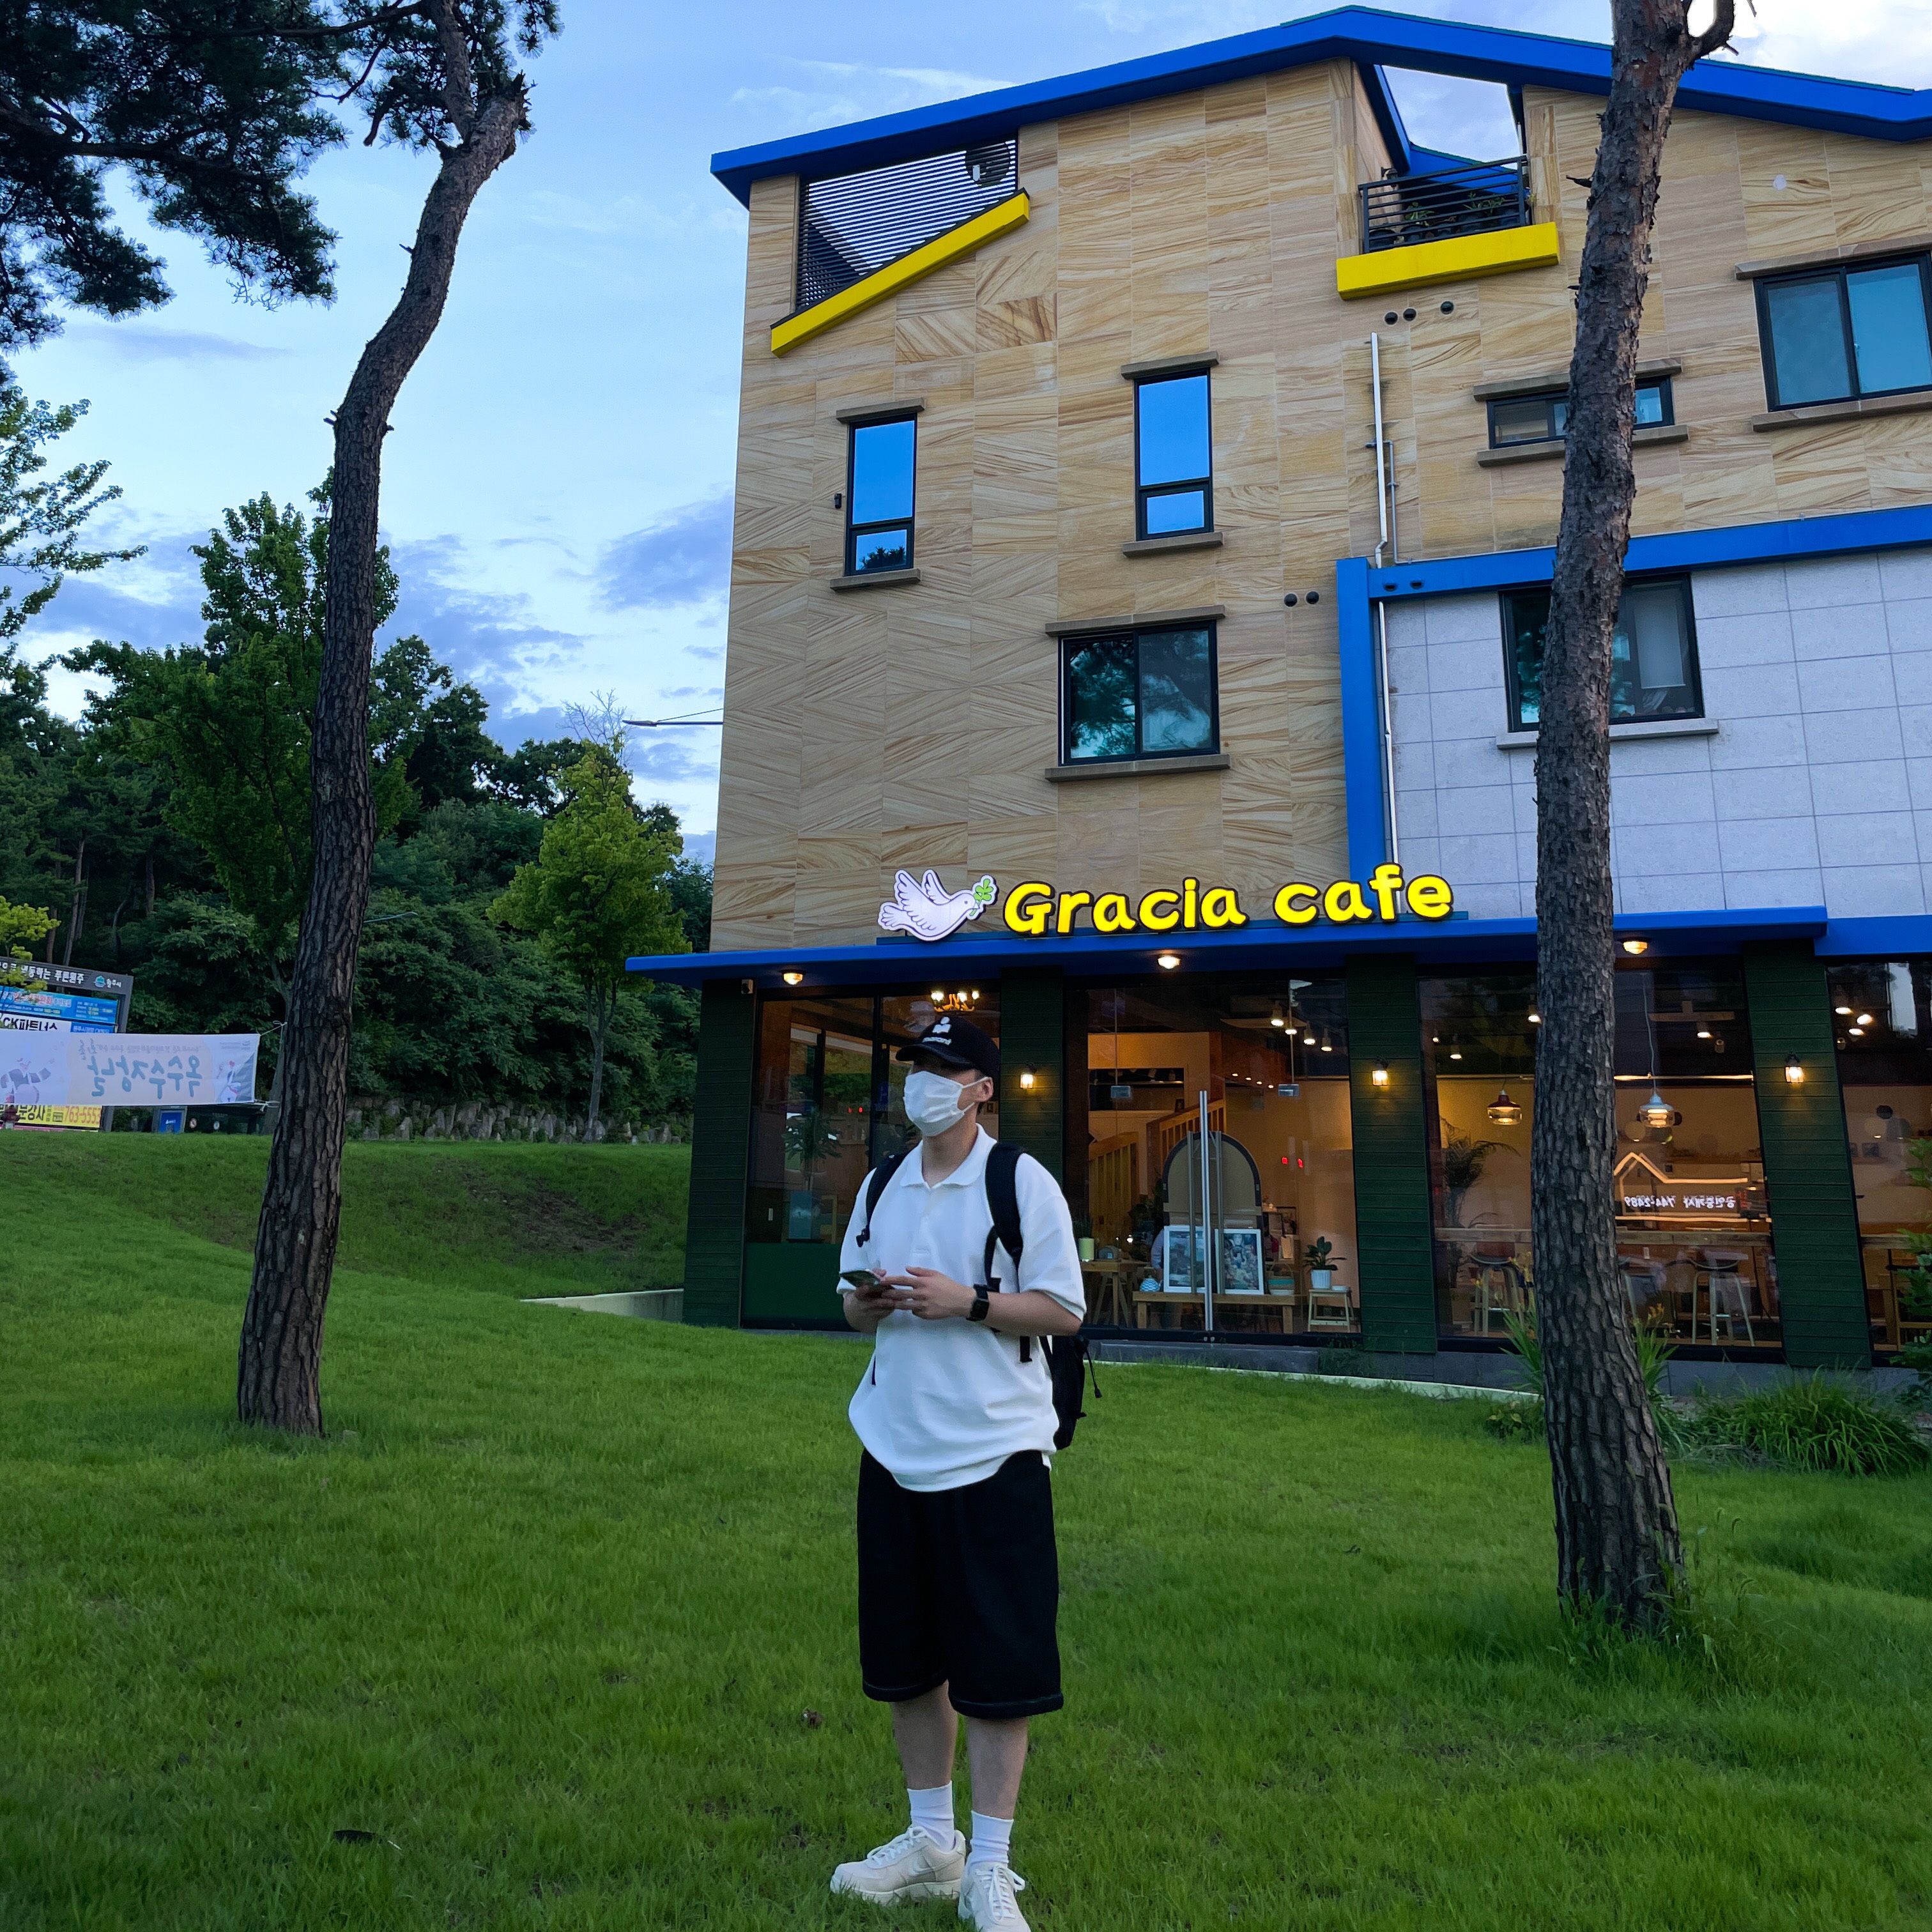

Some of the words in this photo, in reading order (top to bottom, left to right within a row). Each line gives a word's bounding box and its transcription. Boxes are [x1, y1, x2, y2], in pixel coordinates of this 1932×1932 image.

[1004, 877, 1250, 937] Gracia
[1273, 862, 1455, 926] cafe
[54, 969, 84, 985] 푸른원주
